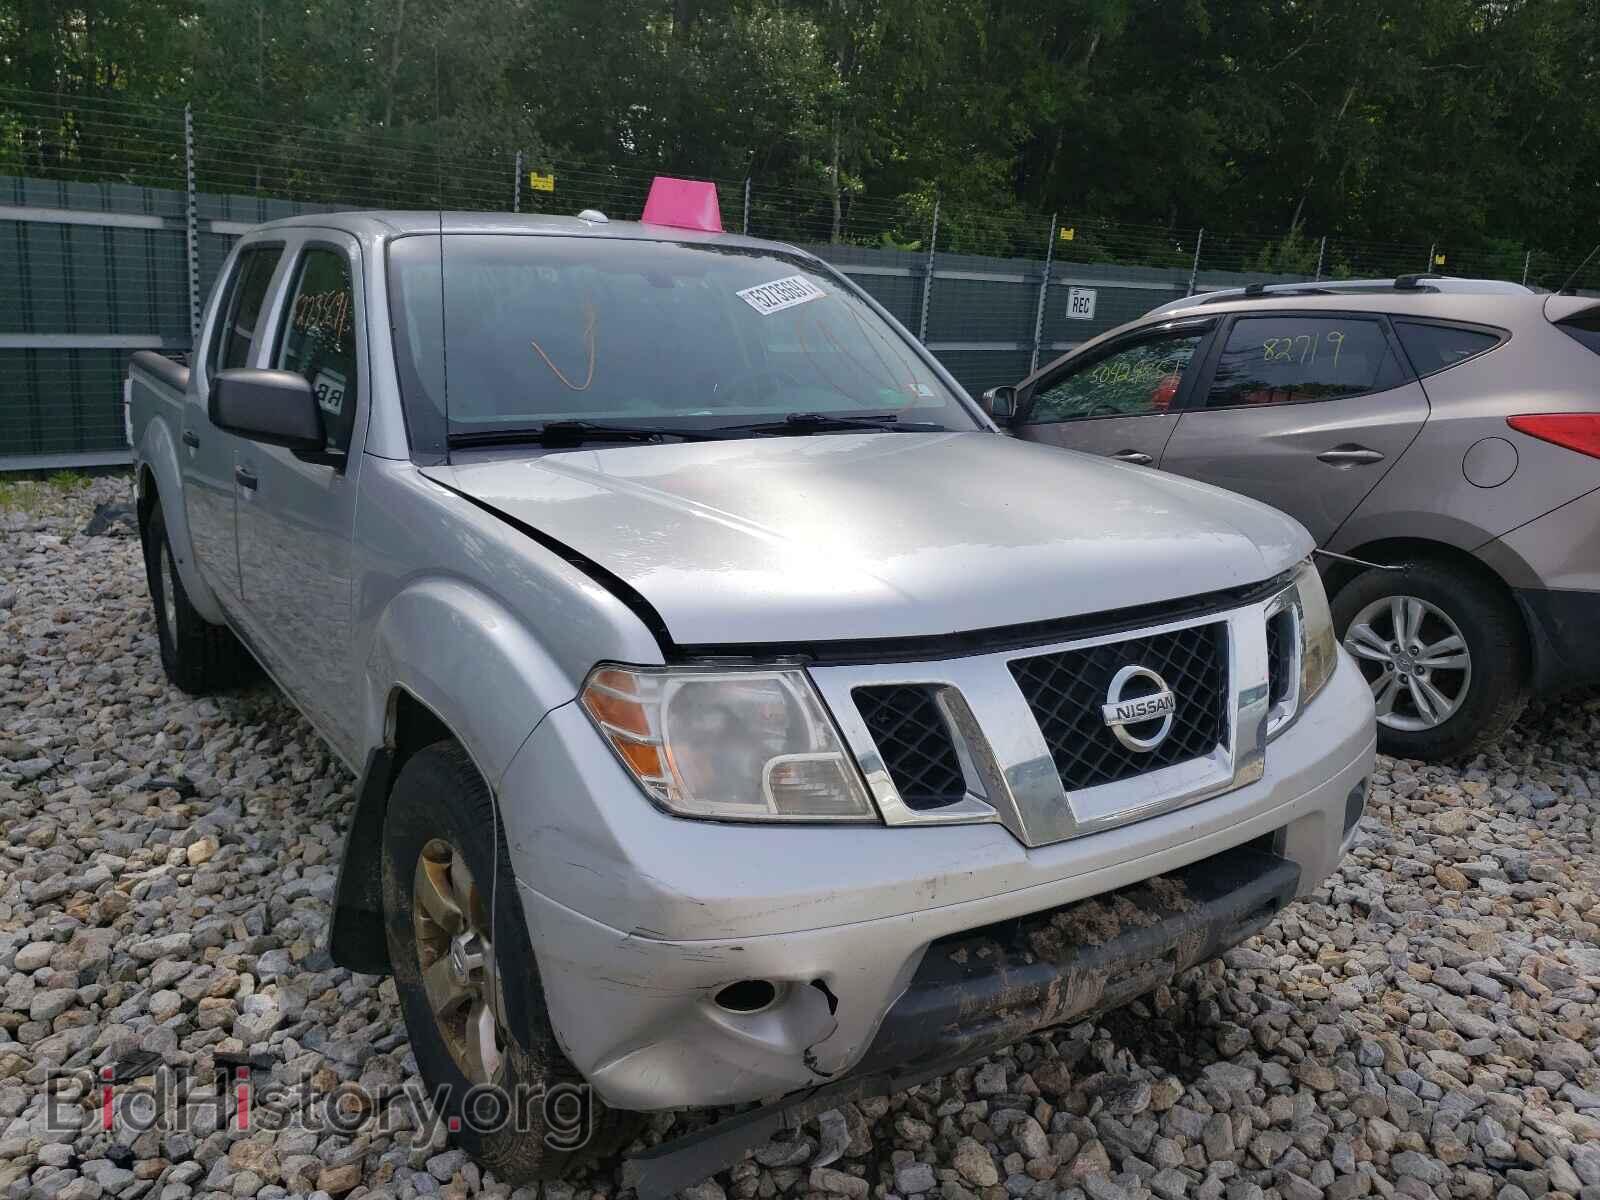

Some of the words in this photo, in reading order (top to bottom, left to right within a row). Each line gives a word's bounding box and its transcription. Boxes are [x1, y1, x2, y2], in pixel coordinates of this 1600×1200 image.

[748, 278, 814, 308] 52735691
[1072, 296, 1090, 314] REC
[1263, 331, 1345, 368] 82719
[1115, 695, 1175, 720] NISSAN
